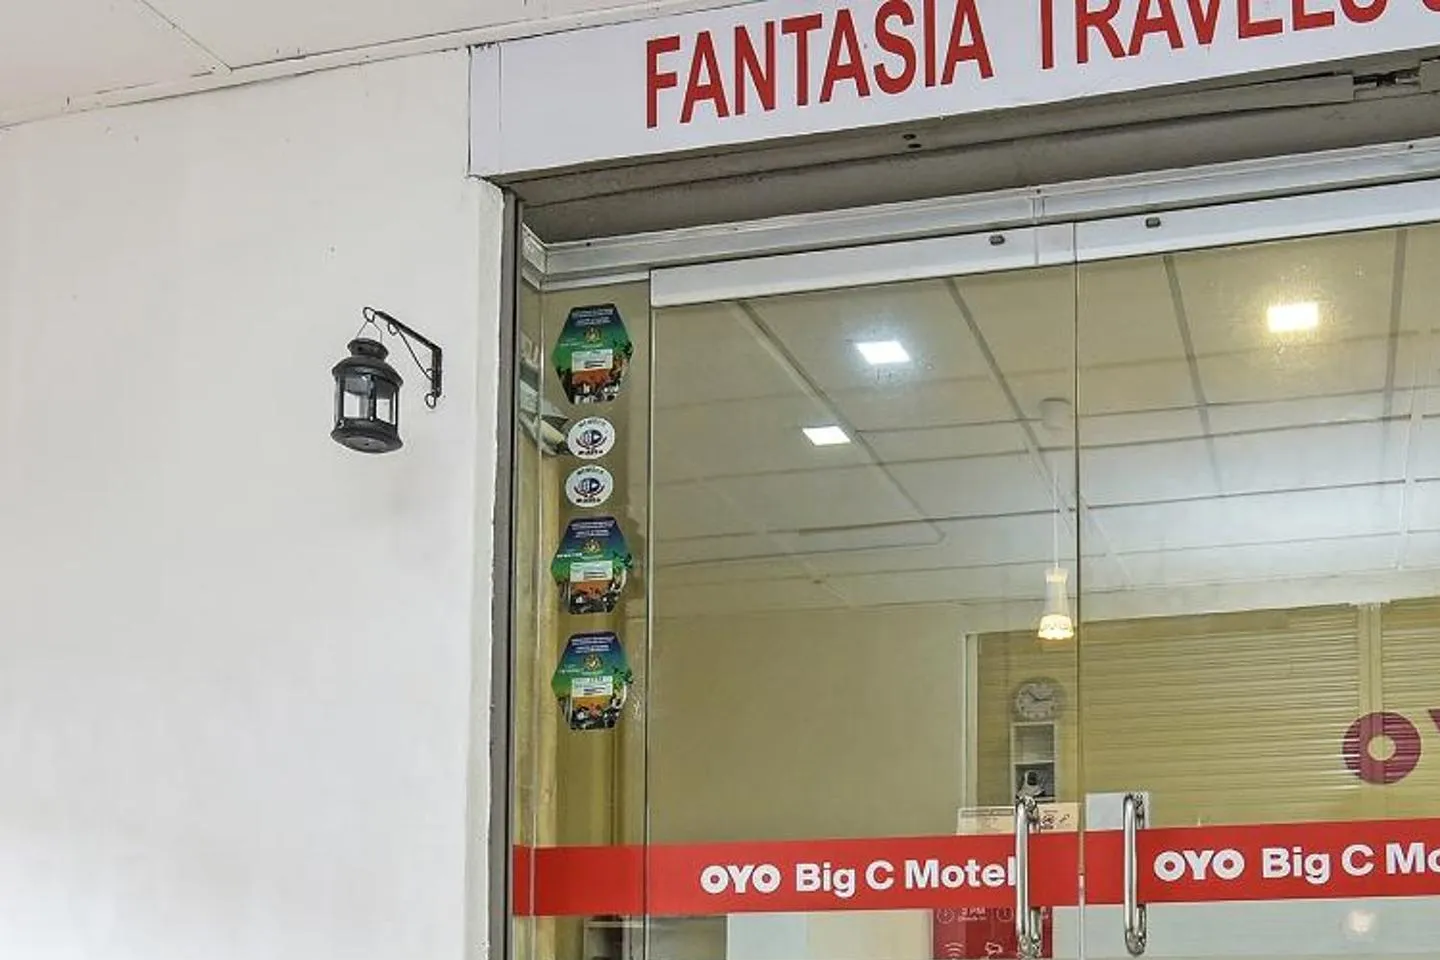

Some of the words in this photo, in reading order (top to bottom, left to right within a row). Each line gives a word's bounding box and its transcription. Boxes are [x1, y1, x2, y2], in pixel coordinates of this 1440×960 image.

[648, 0, 993, 125] FANTASIA
[700, 863, 781, 894] OYO
[796, 862, 856, 898] Big
[865, 860, 894, 890] C
[905, 856, 1017, 889] Motel
[1154, 849, 1245, 882] OYO
[1262, 847, 1330, 885] Big
[1341, 844, 1374, 876] C
